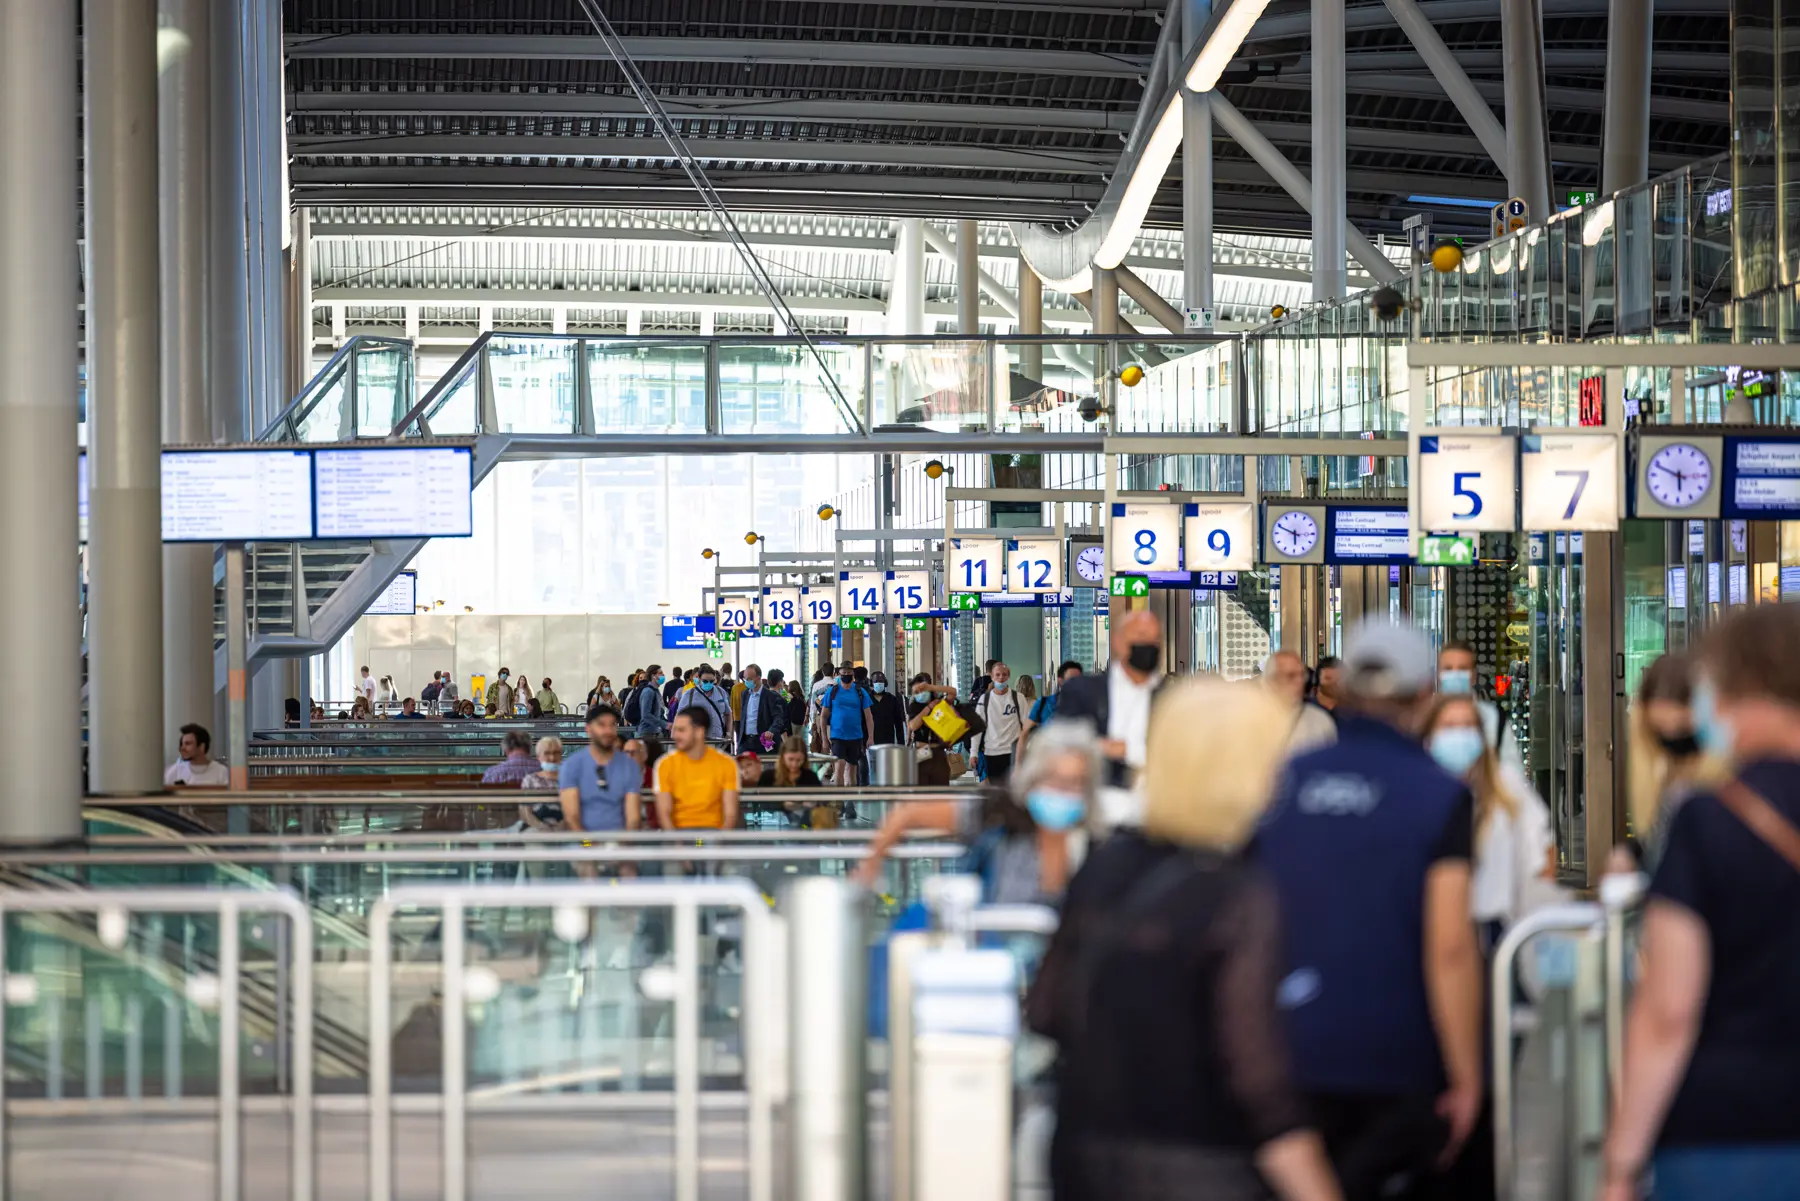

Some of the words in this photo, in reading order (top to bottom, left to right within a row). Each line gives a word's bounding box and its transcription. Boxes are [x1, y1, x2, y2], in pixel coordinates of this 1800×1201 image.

[1453, 472, 1482, 518] 5
[1556, 472, 1588, 519] 7
[1134, 529, 1157, 565] 8
[1207, 529, 1231, 561] 9
[960, 559, 987, 587] 11
[1017, 559, 1053, 588] 12
[768, 599, 795, 620] 18
[807, 600, 833, 620] 19
[848, 588, 879, 611] 14
[893, 586, 923, 610] 15
[722, 609, 747, 627] 20
